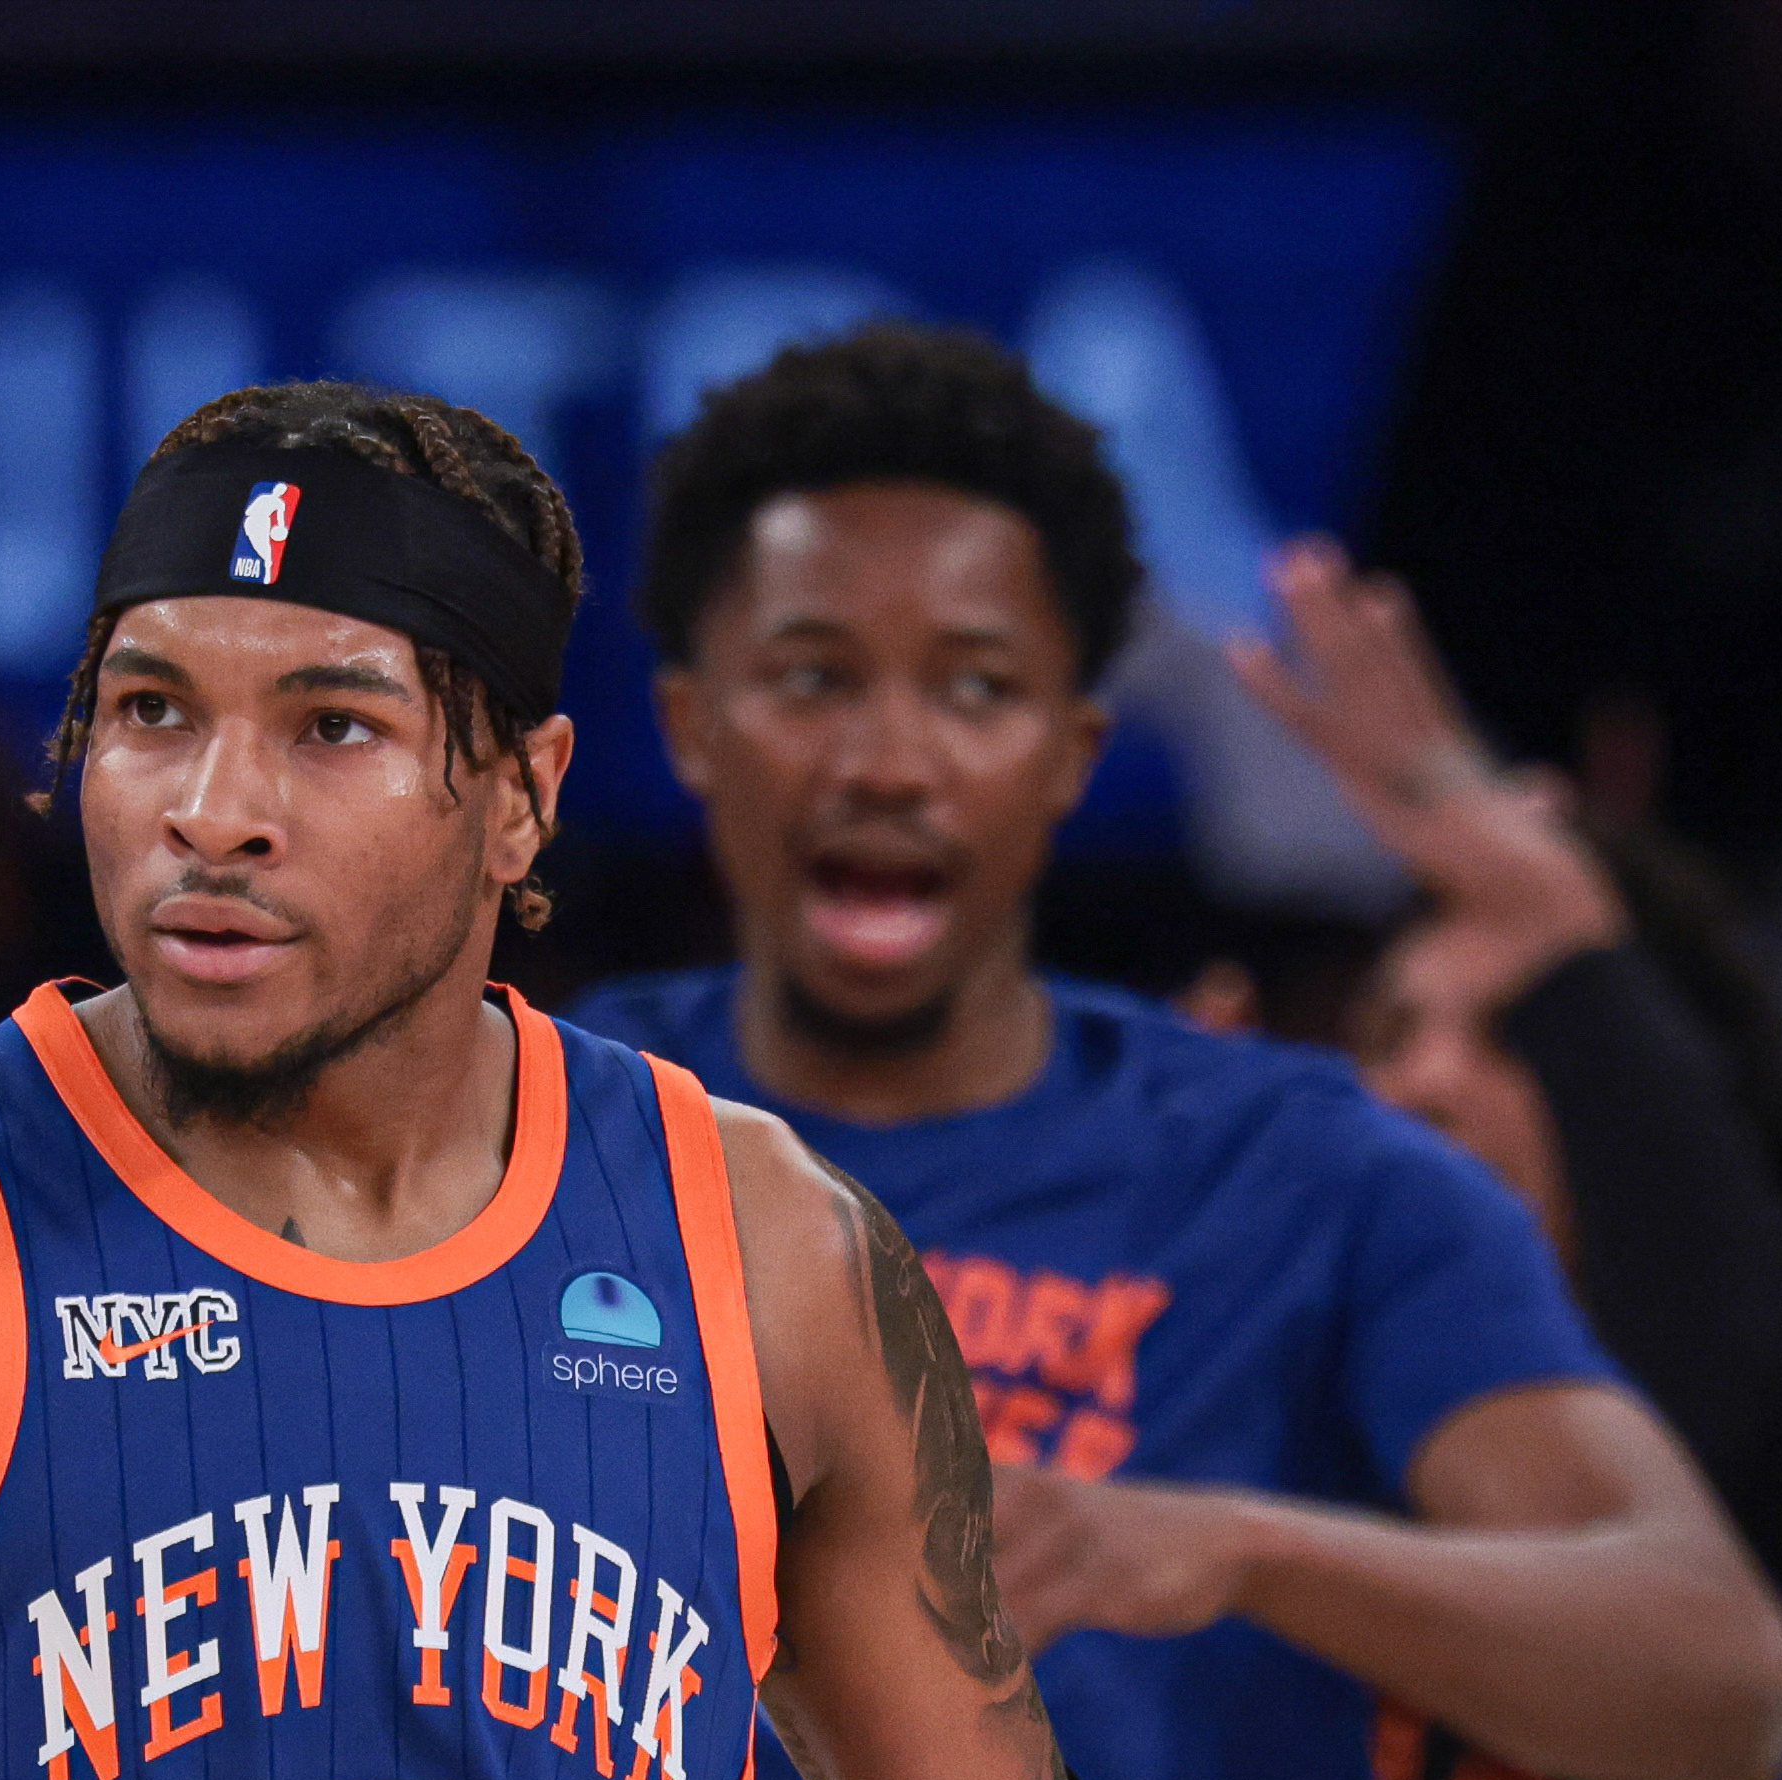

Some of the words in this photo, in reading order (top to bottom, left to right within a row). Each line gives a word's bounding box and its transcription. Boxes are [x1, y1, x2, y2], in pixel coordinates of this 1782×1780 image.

[234, 557, 261, 578] NBA
[55, 1288, 241, 1381] NYC
[553, 1353, 678, 1394] sphere
